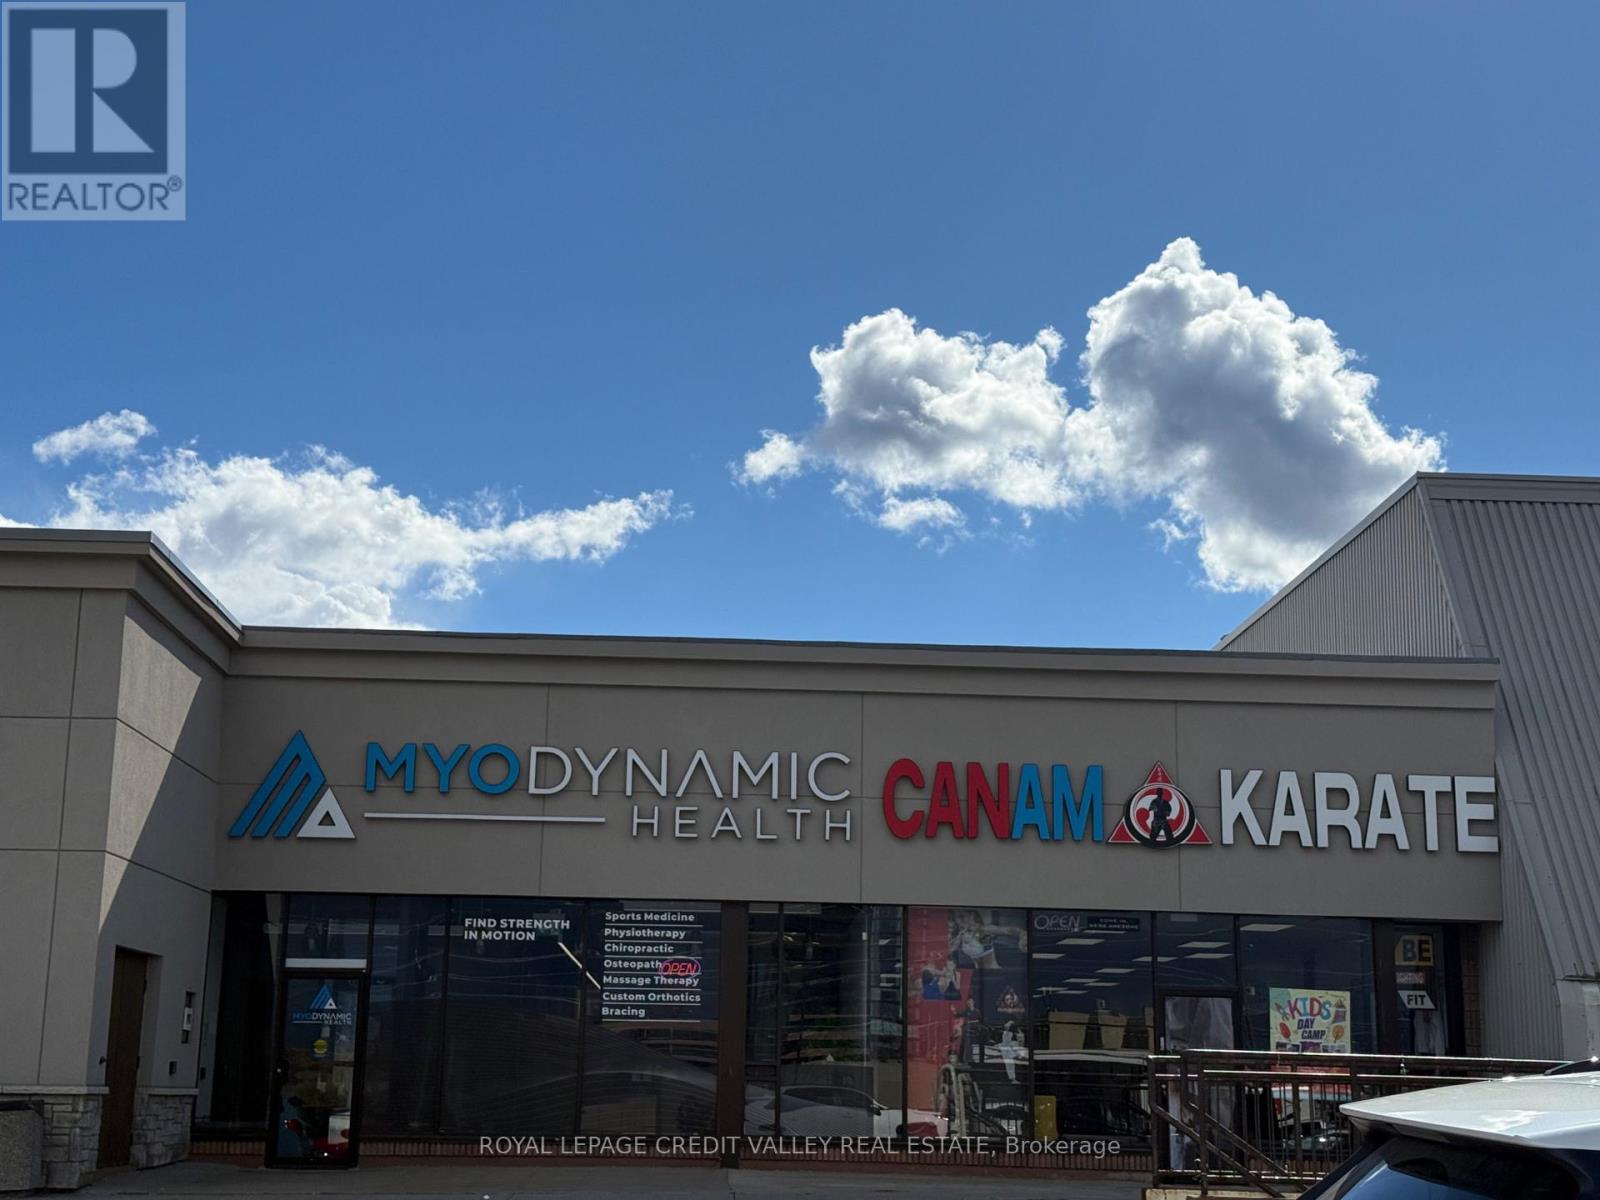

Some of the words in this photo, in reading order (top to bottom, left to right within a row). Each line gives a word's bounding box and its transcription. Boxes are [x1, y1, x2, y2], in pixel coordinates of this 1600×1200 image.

[365, 742, 852, 801] MYODYNAMIC
[882, 758, 1104, 842] CANAM
[1219, 768, 1499, 852] KARATE
[632, 805, 852, 841] HEALTH
[604, 911, 642, 922] Sports
[644, 912, 695, 922] Medicine
[1034, 915, 1081, 930] OPEN
[464, 918, 497, 928] FIND
[500, 918, 570, 930] STRENGTH
[464, 931, 478, 940] IN
[481, 931, 536, 941] MOTION
[604, 927, 686, 939] Physiotherapy
[604, 943, 674, 954] Chiropractic
[1403, 939, 1431, 962] BE
[603, 959, 669, 970] Osteopath
[661, 963, 698, 976] OPEN
[602, 975, 652, 986] Massage
[654, 976, 700, 987] Therapy
[602, 992, 645, 1001] Custom
[647, 992, 701, 1002] Orthotics
[1407, 994, 1426, 1006] FIT
[601, 1006, 646, 1018] Bracing
[1287, 997, 1332, 1020] KIDS
[1297, 1018, 1316, 1030] DAY
[1301, 1029, 1327, 1041] CAMP
